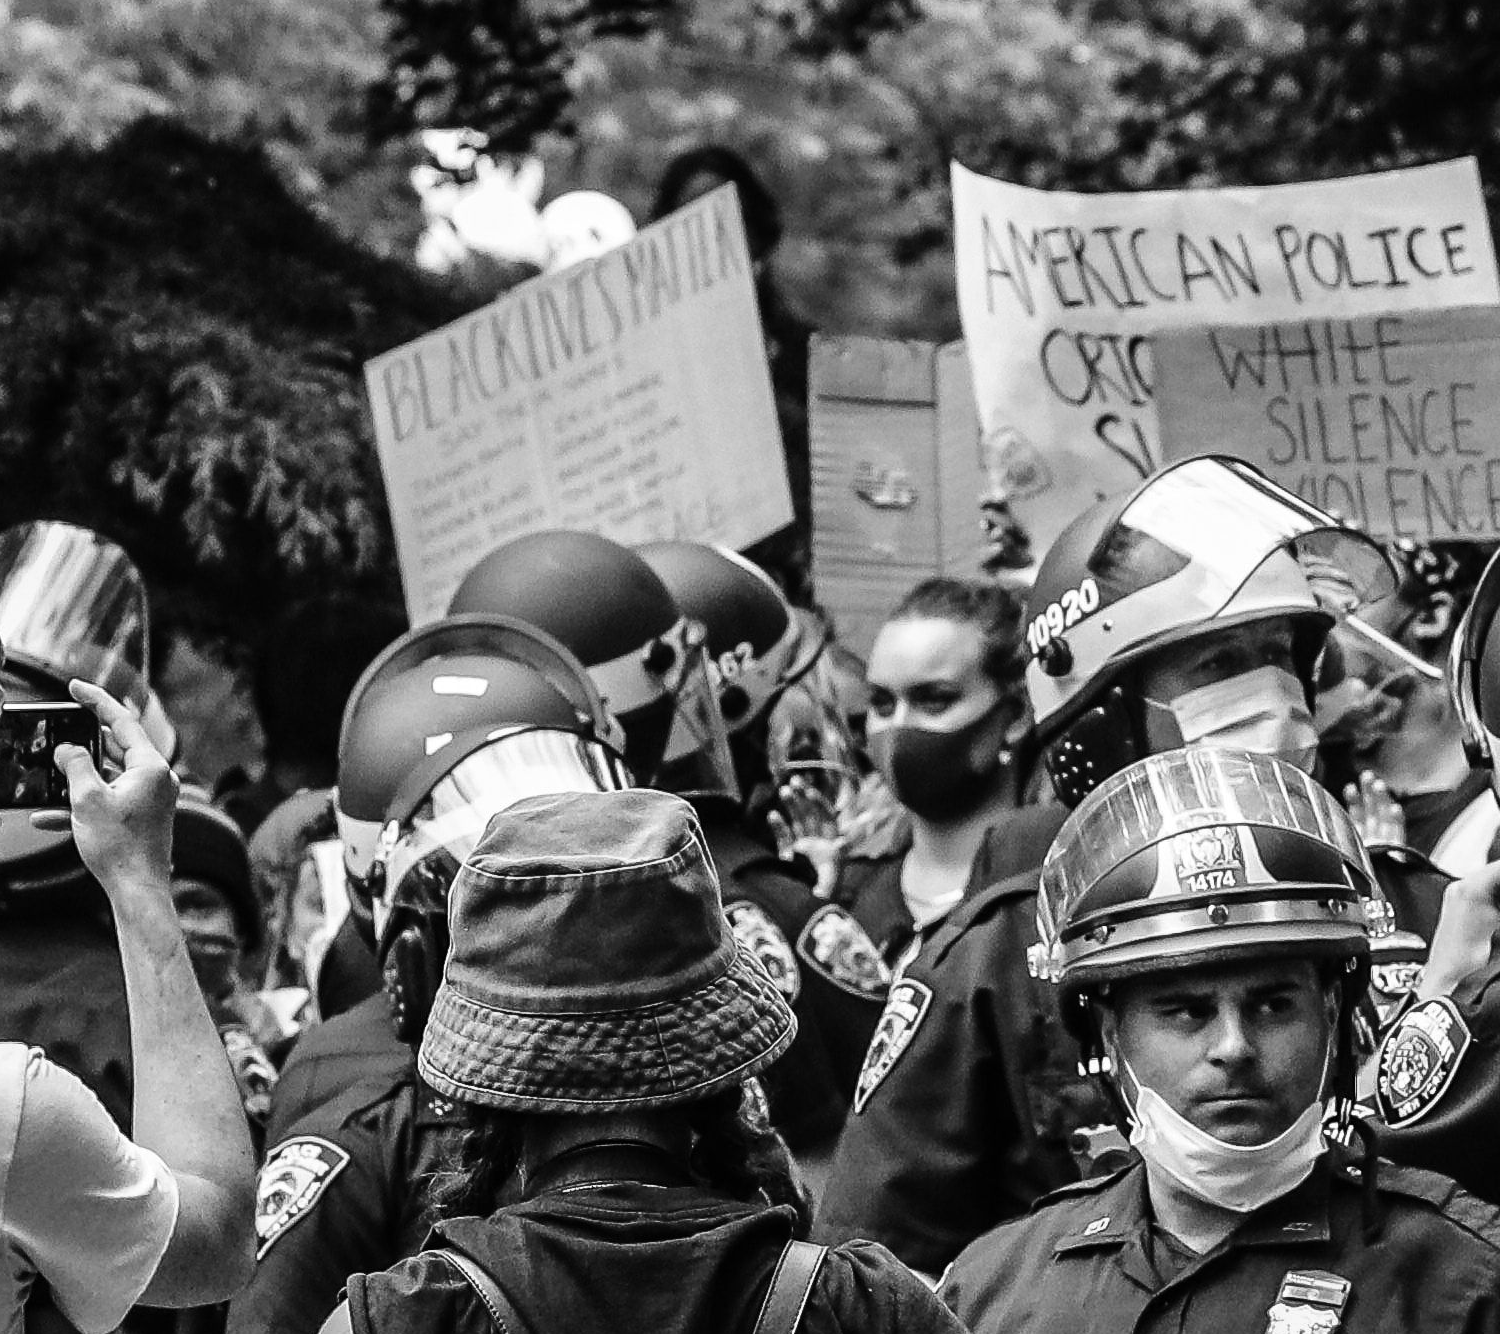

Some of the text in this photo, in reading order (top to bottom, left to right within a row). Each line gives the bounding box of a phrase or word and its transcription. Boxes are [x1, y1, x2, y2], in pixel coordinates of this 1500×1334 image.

[980, 213, 1474, 318] AMERICAN POLICE
[1266, 382, 1484, 466] SILENCE
[1027, 579, 1099, 654] 10920
[1187, 870, 1236, 892] 14174
